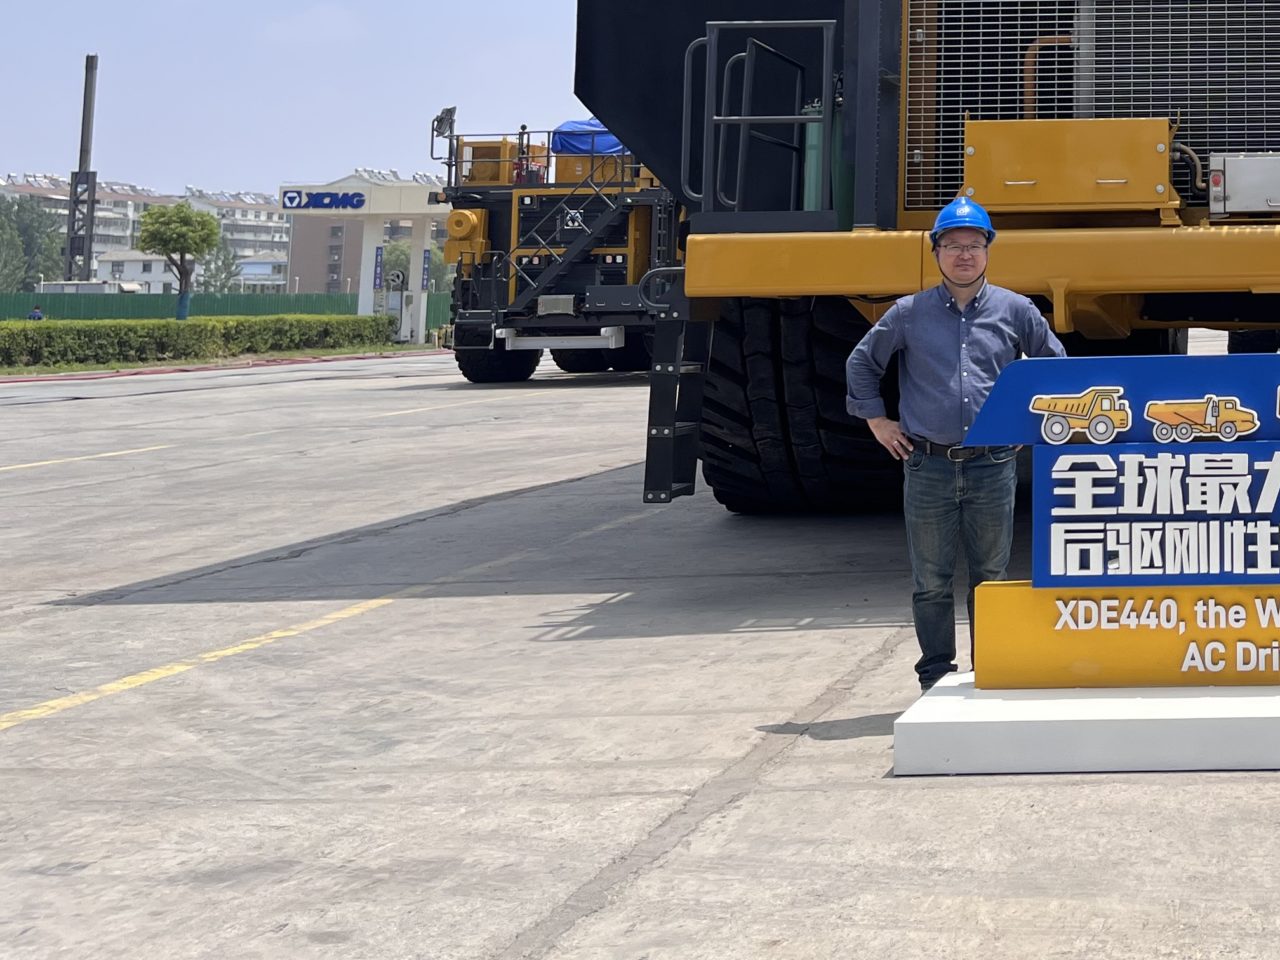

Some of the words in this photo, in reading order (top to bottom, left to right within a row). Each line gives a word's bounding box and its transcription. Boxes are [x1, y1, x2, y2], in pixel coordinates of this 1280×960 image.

[302, 192, 366, 209] XCMG
[1053, 597, 1187, 635] XDE440,
[1193, 597, 1247, 629] the
[1180, 640, 1226, 672] AC
